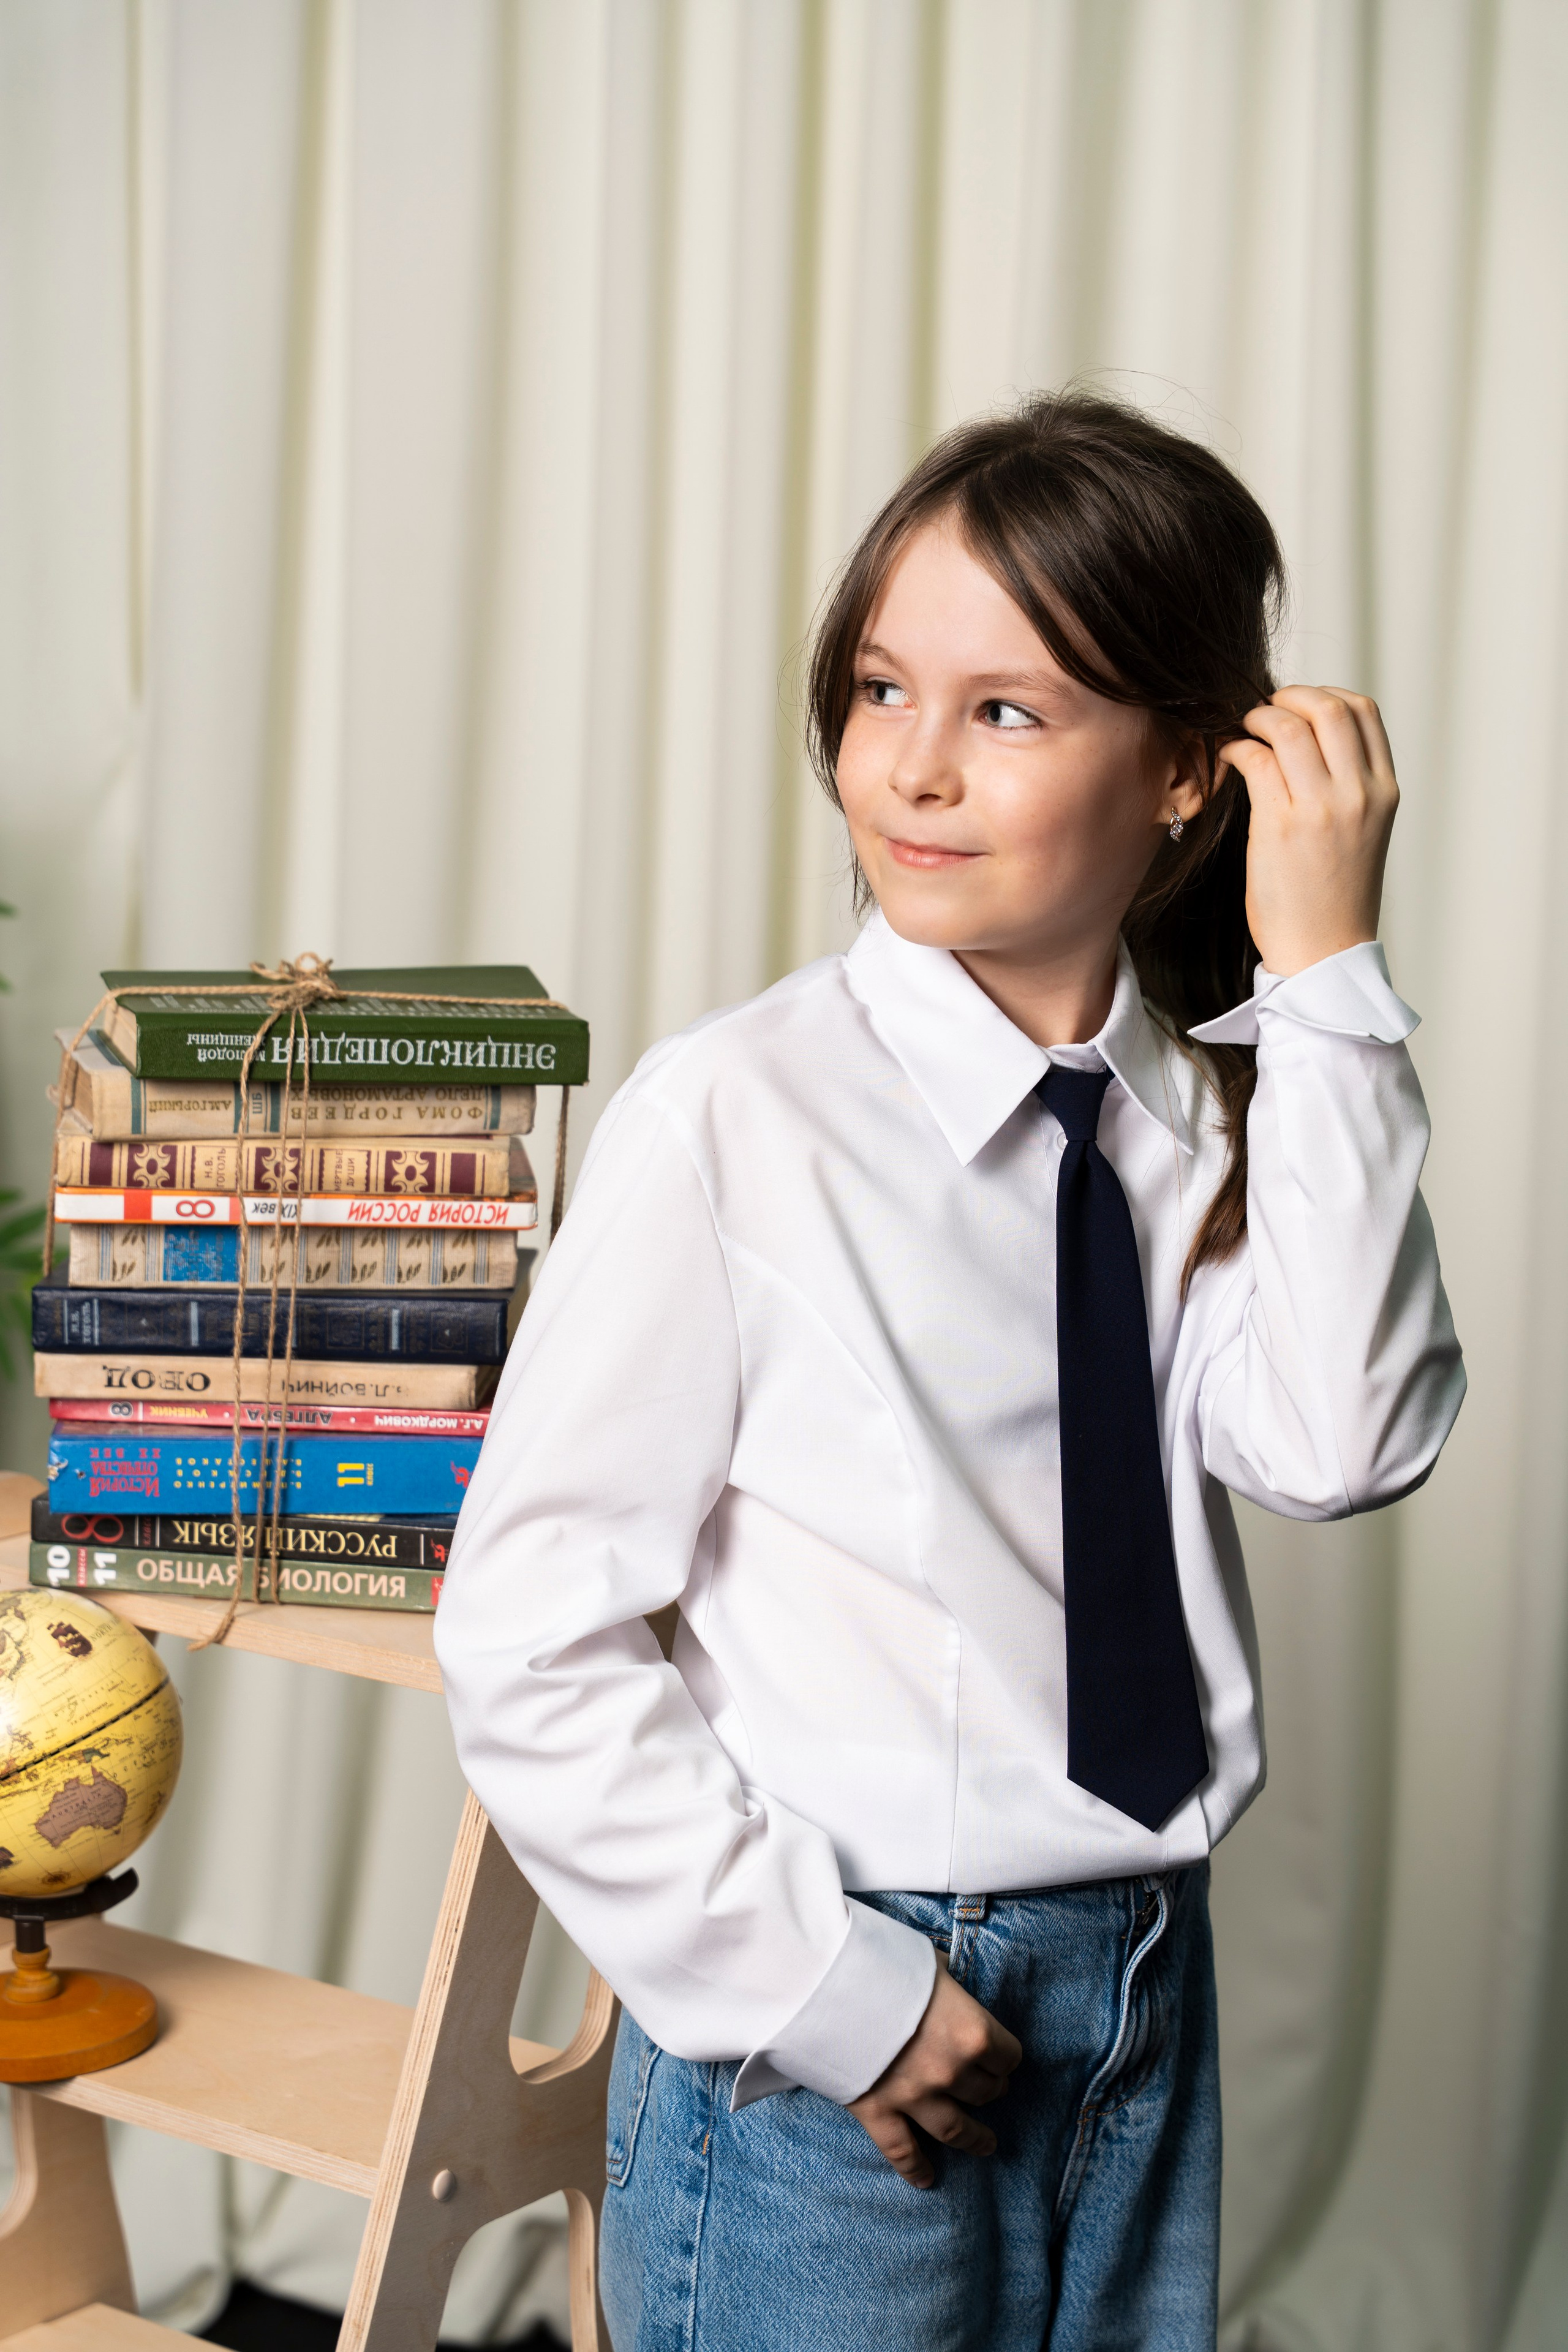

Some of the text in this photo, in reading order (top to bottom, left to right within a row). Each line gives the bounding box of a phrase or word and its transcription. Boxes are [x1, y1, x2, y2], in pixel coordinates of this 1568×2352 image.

[197, 1047, 265, 1063] МЛОДОЙ
[271, 1031, 556, 1069] ЭНЦИКЛОПЕДИЯ
[435, 1085, 485, 1101] ДЕЛО
[291, 1103, 483, 1120] ФОМА ГОРДЕЕВ
[205, 1157, 213, 1178] Н.В.
[216, 1148, 226, 1187] ГОГОЛЬ
[334, 1149, 343, 1191] МЕРТВЫЕ
[176, 1199, 215, 1218] 8
[252, 1202, 276, 1214] век
[347, 1201, 510, 1224] ИСТОРИЯ РОССИИ
[82, 1301, 91, 1344] ГОГОЛЬ
[102, 1365, 211, 1391] ОВОД
[109, 1401, 134, 1419] 8
[150, 1405, 209, 1419] УЧЕБНИК
[246, 1408, 333, 1425] АЛГЕБРА
[374, 1415, 483, 1431] А.Г. МОРДКОВИЧ
[89, 1448, 125, 1458] ВЕК
[91, 1461, 157, 1476] ОТЕЧЕСТВА
[337, 1463, 364, 1487] 11
[61, 1513, 124, 1543] 8
[172, 1520, 398, 1558] РУССКИЙ ЯЗЫК
[47, 1545, 70, 1587] 10
[94, 1552, 116, 1585] 11
[136, 1558, 405, 1599] ОБЩАЯ БИОЛОГИЯ
